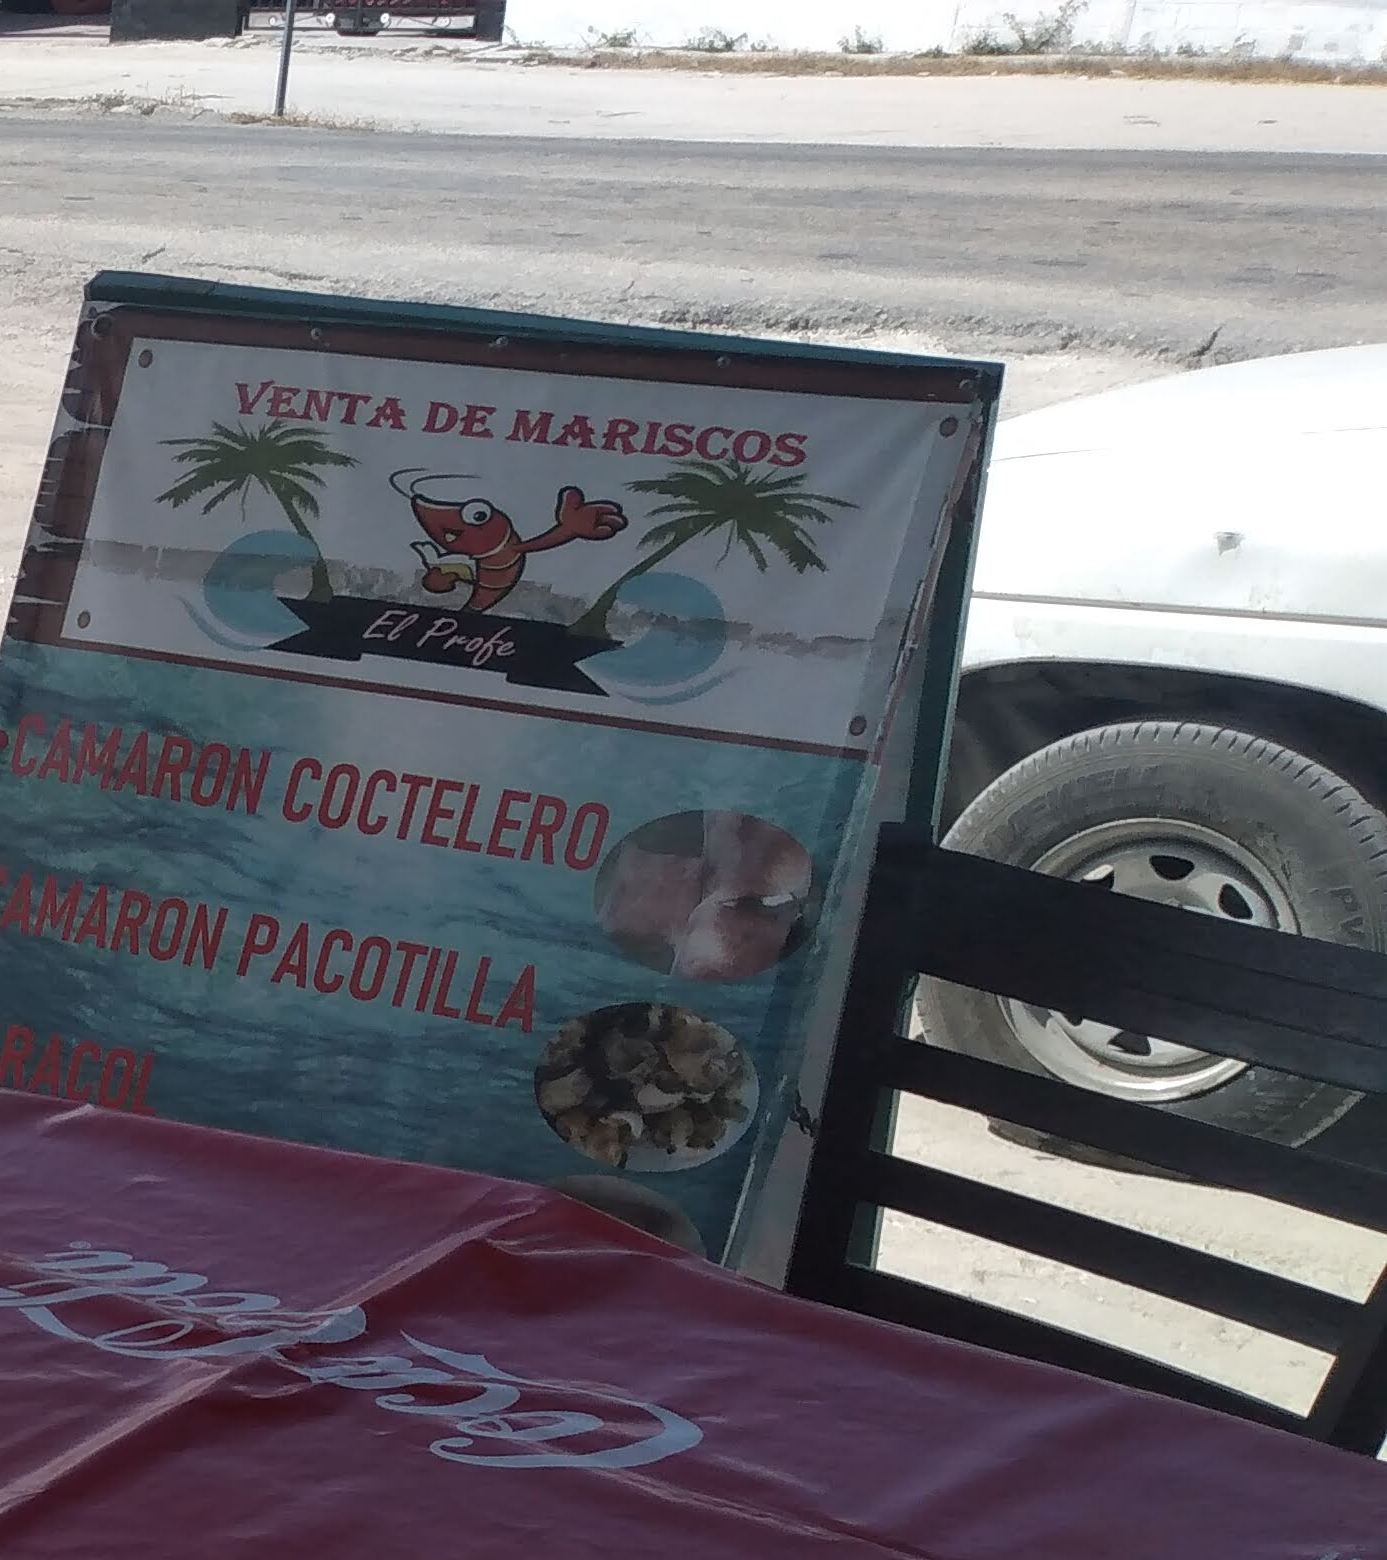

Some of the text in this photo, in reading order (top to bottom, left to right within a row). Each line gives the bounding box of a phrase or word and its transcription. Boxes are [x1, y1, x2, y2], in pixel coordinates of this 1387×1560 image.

[234, 380, 809, 468] VENTA DE MARISCOS
[362, 609, 516, 666] El Profe
[11, 713, 611, 872] CAMARON COCTELERO
[235, 912, 537, 1034] PACOTILLA
